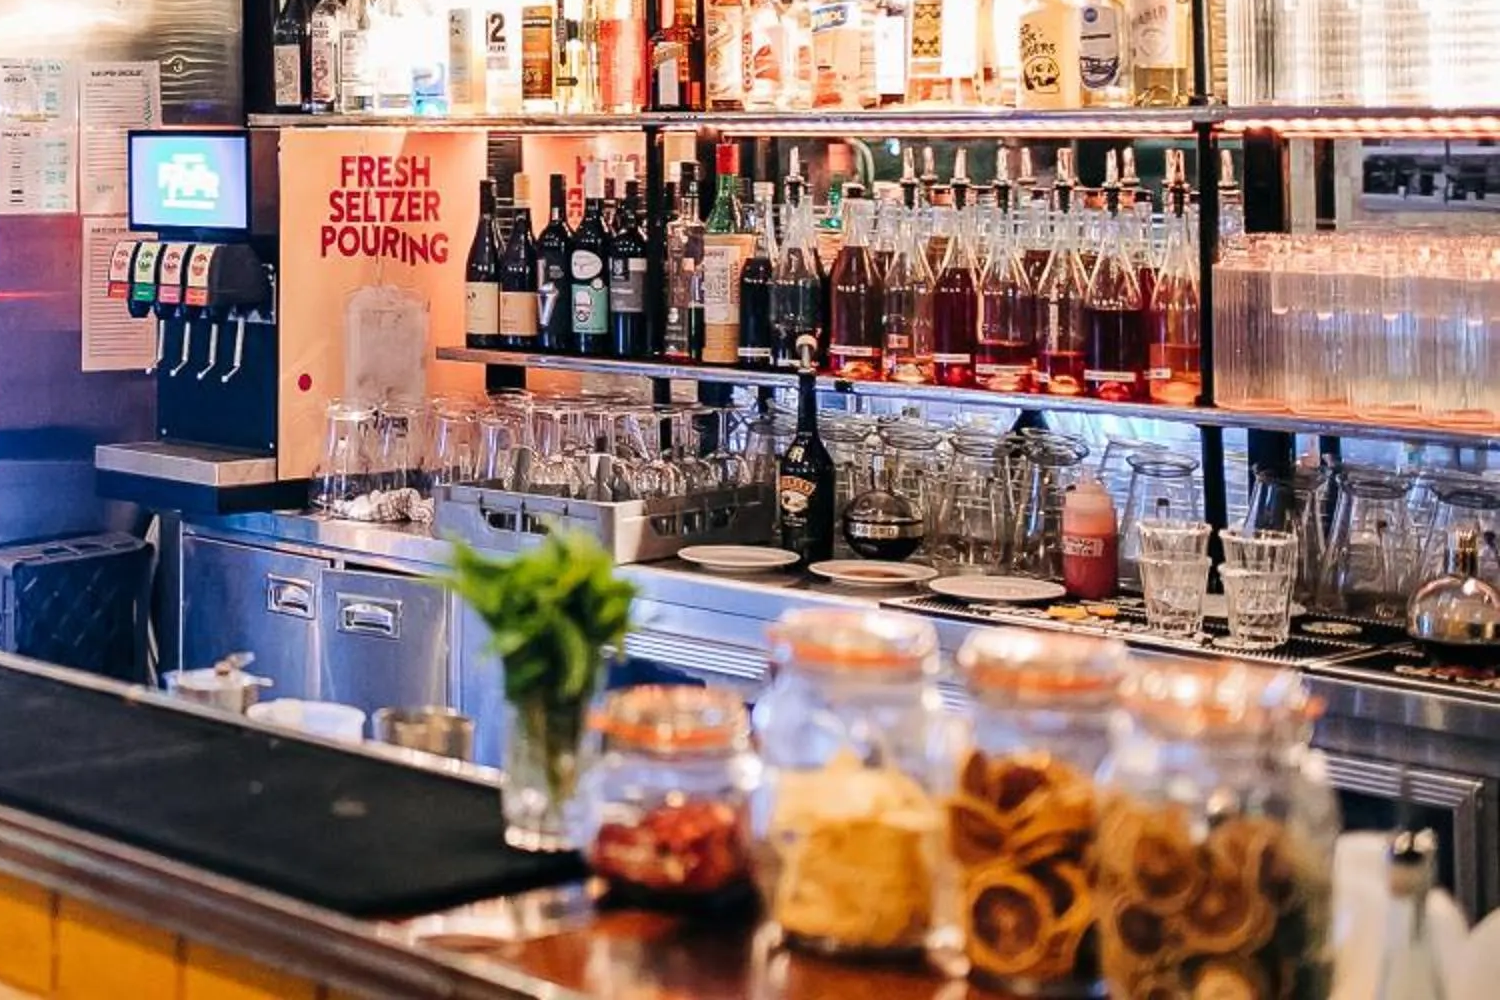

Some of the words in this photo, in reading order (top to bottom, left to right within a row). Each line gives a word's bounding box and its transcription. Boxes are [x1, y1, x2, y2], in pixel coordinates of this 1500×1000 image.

[341, 154, 431, 189] FRESH
[329, 189, 441, 223] SELTZER
[320, 225, 449, 267] POURING
